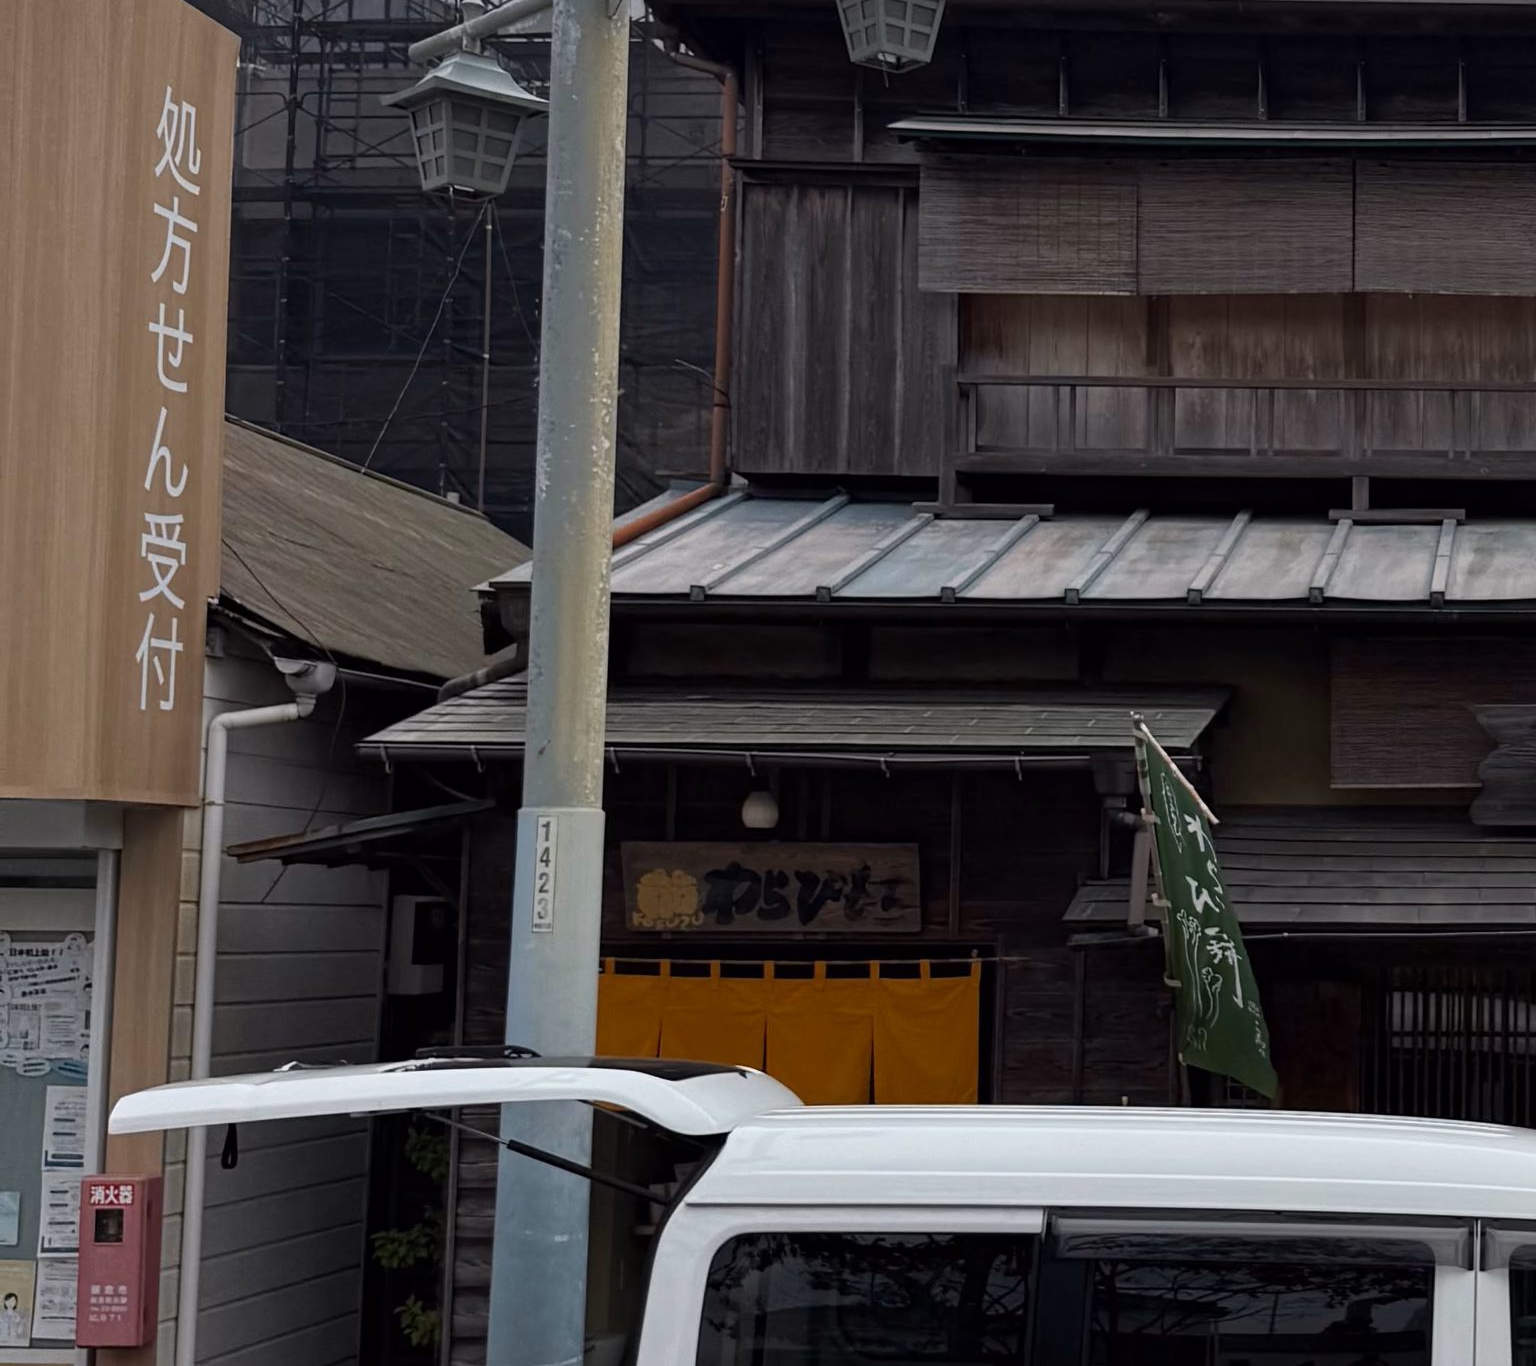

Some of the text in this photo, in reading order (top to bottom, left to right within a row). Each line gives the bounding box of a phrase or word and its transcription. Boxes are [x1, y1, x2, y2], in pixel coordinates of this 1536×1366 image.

[135, 85, 202, 712] 処方せん受付
[537, 820, 551, 920] 1423
[90, 1185, 133, 1205] 消火器
